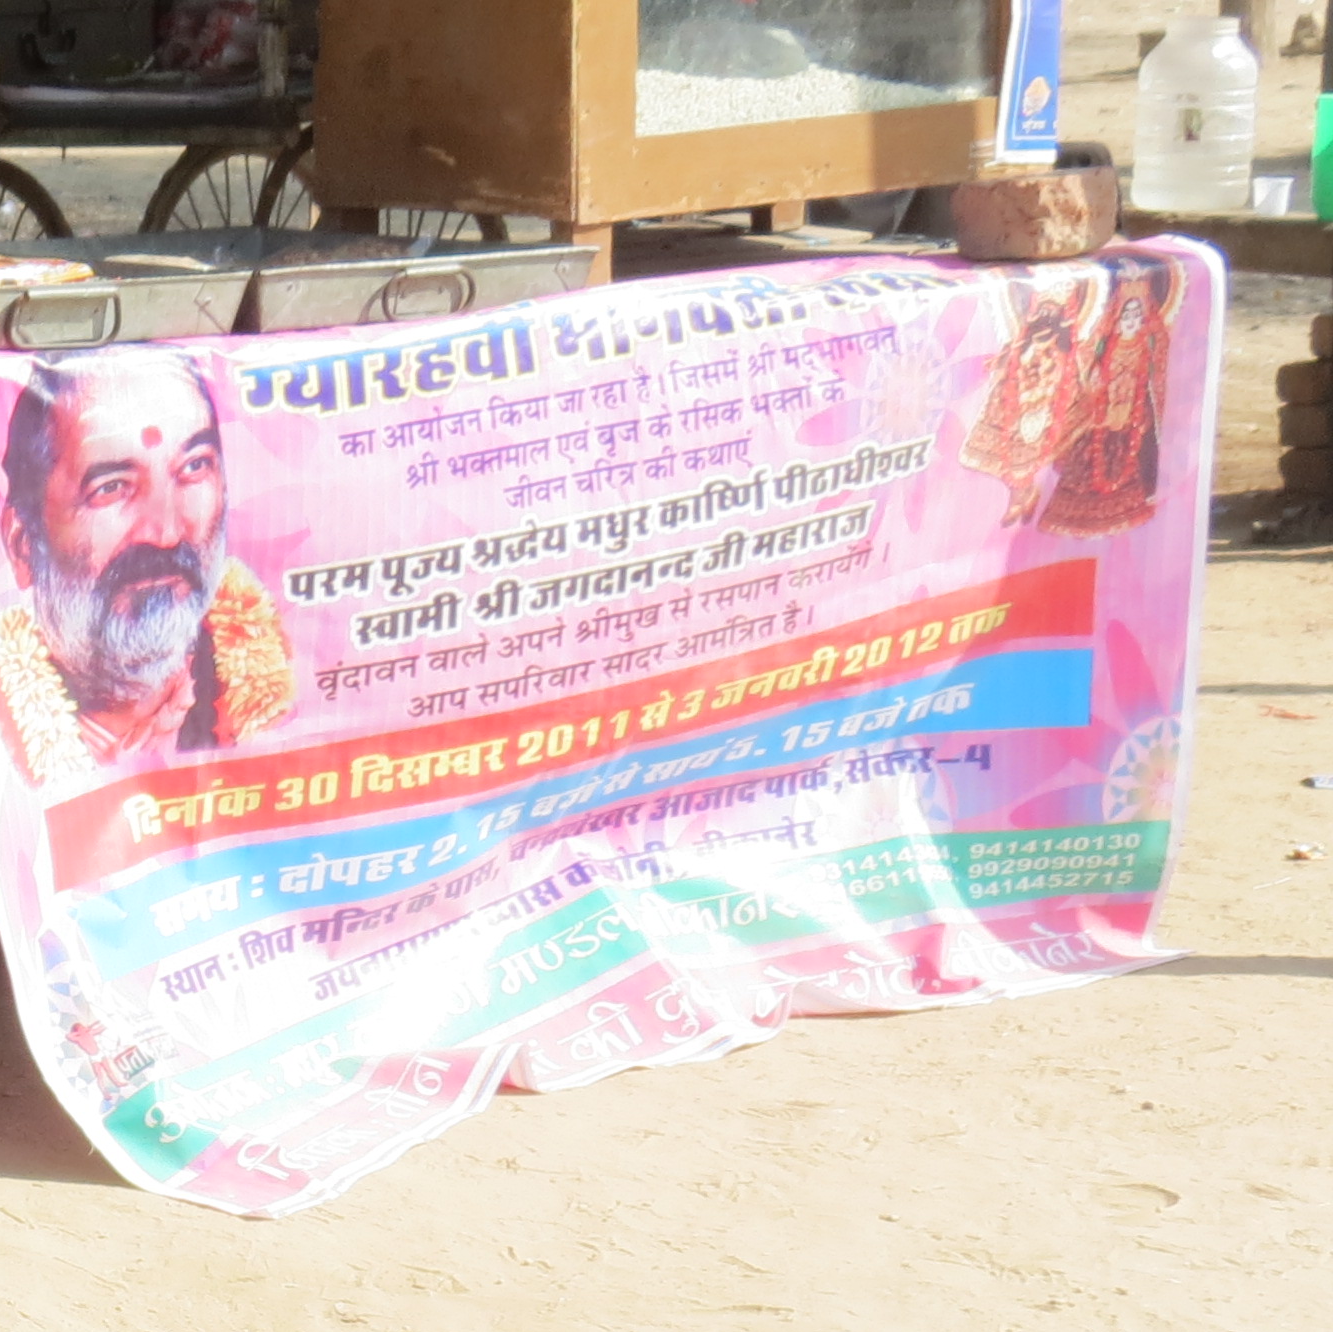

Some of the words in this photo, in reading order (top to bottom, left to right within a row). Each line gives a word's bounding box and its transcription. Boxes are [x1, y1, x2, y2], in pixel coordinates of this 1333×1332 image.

[339, 429, 375, 457] का
[384, 406, 482, 448] आयोजन
[487, 396, 549, 429] किया
[555, 388, 585, 415] जा
[590, 379, 627, 409] रहा
[748, 342, 775, 377] श्री
[406, 451, 439, 490] श्री
[448, 437, 551, 478] भक्तमाल
[556, 421, 590, 463] एवं
[595, 419, 640, 458] बृज
[646, 403, 672, 438] के
[682, 398, 743, 434] रसिक
[751, 376, 811, 416] भक्तों
[818, 369, 844, 402] के
[504, 475, 567, 509] जीवन
[572, 458, 637, 494] चरित्र
[643, 445, 676, 480] की
[683, 430, 754, 471] कथाएं
[289, 560, 373, 600] परम
[383, 544, 463, 596] पूज्य
[472, 520, 568, 567] श्रद्धेय
[577, 505, 651, 550] मधुर
[356, 590, 463, 645] स्वामी
[473, 579, 523, 620] श्री
[530, 548, 696, 611] जगदानन्द
[702, 531, 749, 572] जी
[753, 504, 873, 558] महाराज
[315, 655, 420, 701] वृंदावन
[427, 632, 489, 672] वाले
[497, 617, 567, 657] अपने
[576, 605, 660, 643] श्रीमुख
[669, 588, 695, 620] से
[699, 573, 783, 613] रसपान
[407, 687, 469, 718] आप
[477, 659, 596, 707] सपरिवार
[602, 642, 664, 680] सादर
[675, 613, 774, 660] आमंत्रित
[123, 779, 266, 843] दिनांक
[274, 771, 338, 812] 30
[351, 738, 508, 798] दिसम्बर
[517, 710, 630, 767] 2011
[639, 690, 675, 733] से
[677, 687, 707, 722] 3
[710, 645, 840, 711] जनवरी
[946, 602, 1012, 649] तक
[278, 844, 425, 896] दोपहर
[838, 696, 906, 738] बजे
[906, 683, 975, 722] तक
[159, 953, 227, 1003] स्थान
[238, 925, 297, 970] शिव
[300, 902, 400, 944] मन्दिर
[406, 882, 440, 914] के
[650, 778, 762, 822] आजाद
